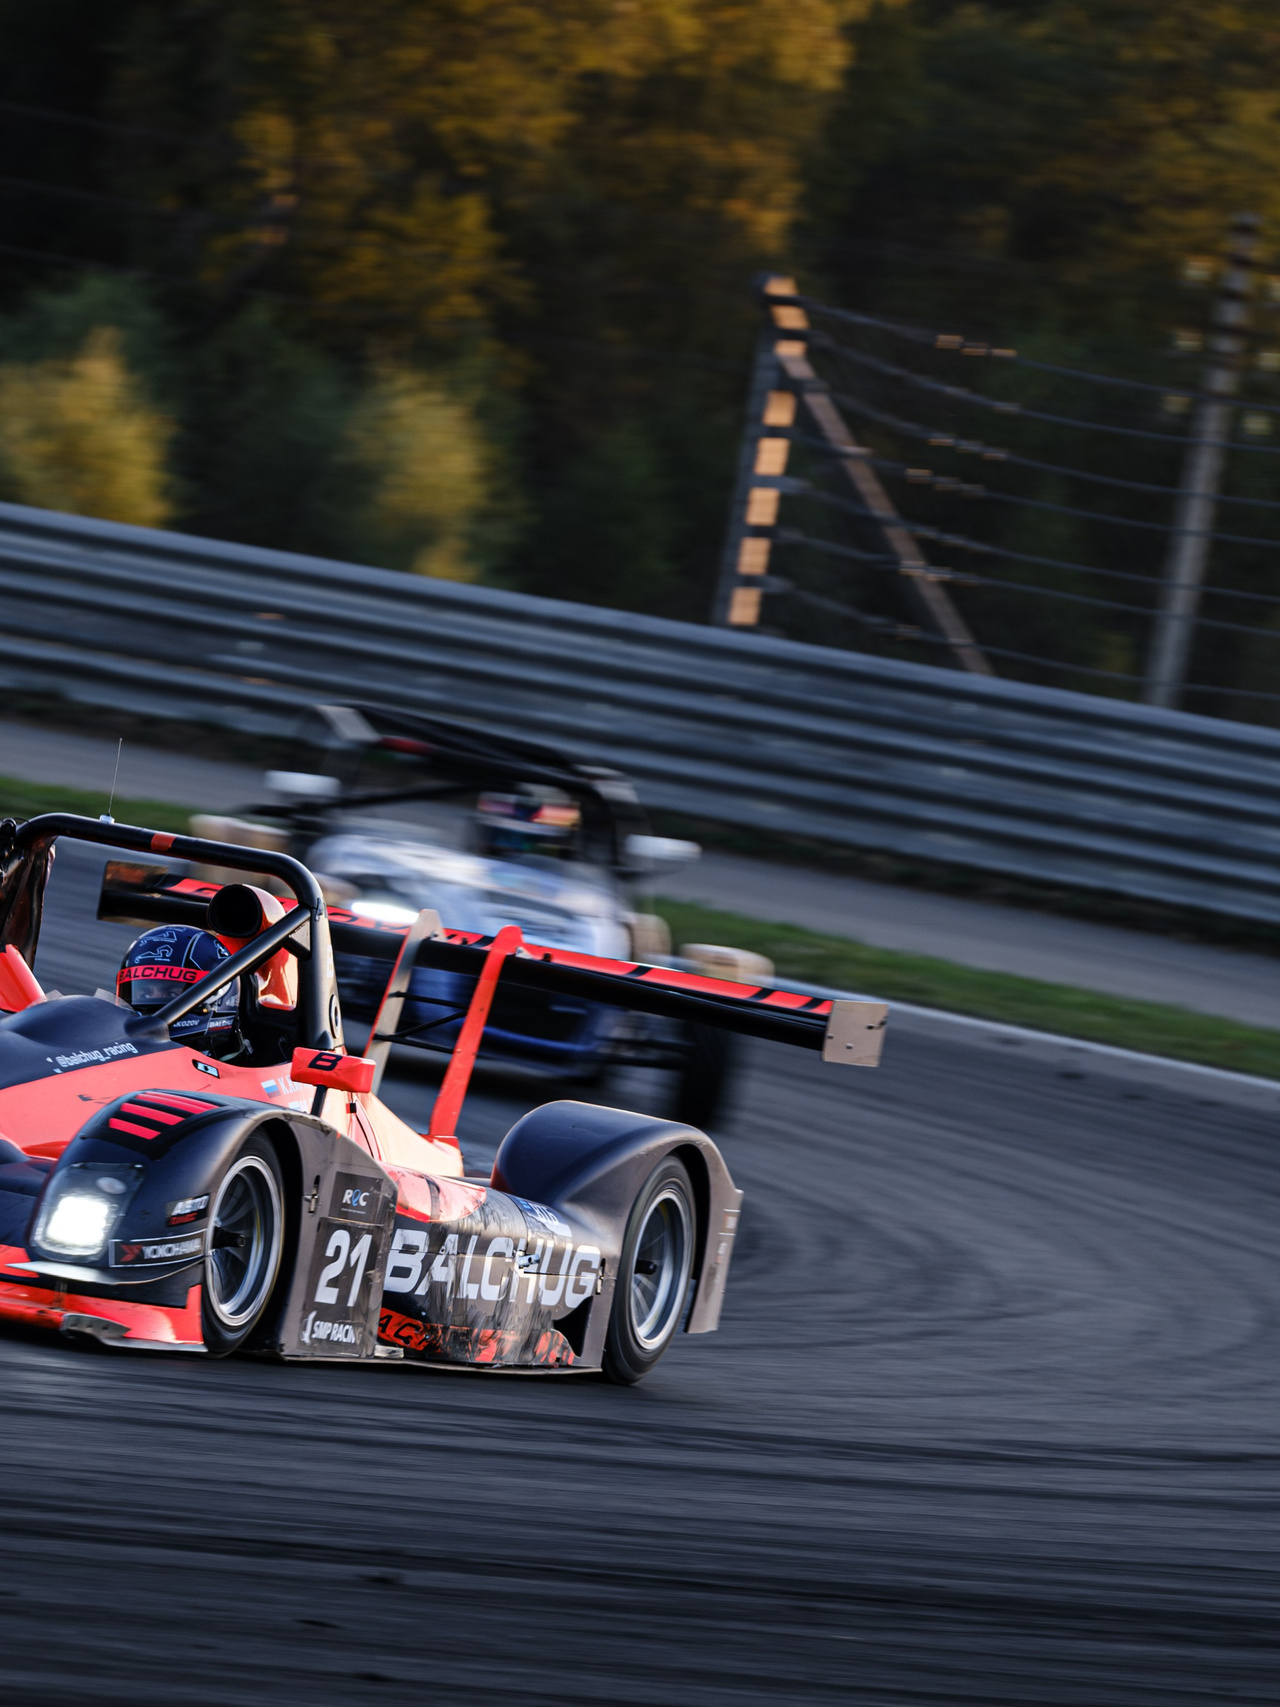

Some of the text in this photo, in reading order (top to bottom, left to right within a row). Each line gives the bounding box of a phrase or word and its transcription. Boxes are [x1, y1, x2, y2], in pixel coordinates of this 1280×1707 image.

[119, 966, 198, 982] BALCHUG
[55, 1041, 139, 1068] @balchug_racing
[308, 1052, 343, 1072] B
[314, 1229, 372, 1307] 21
[383, 1228, 601, 1308] BALCHUG
